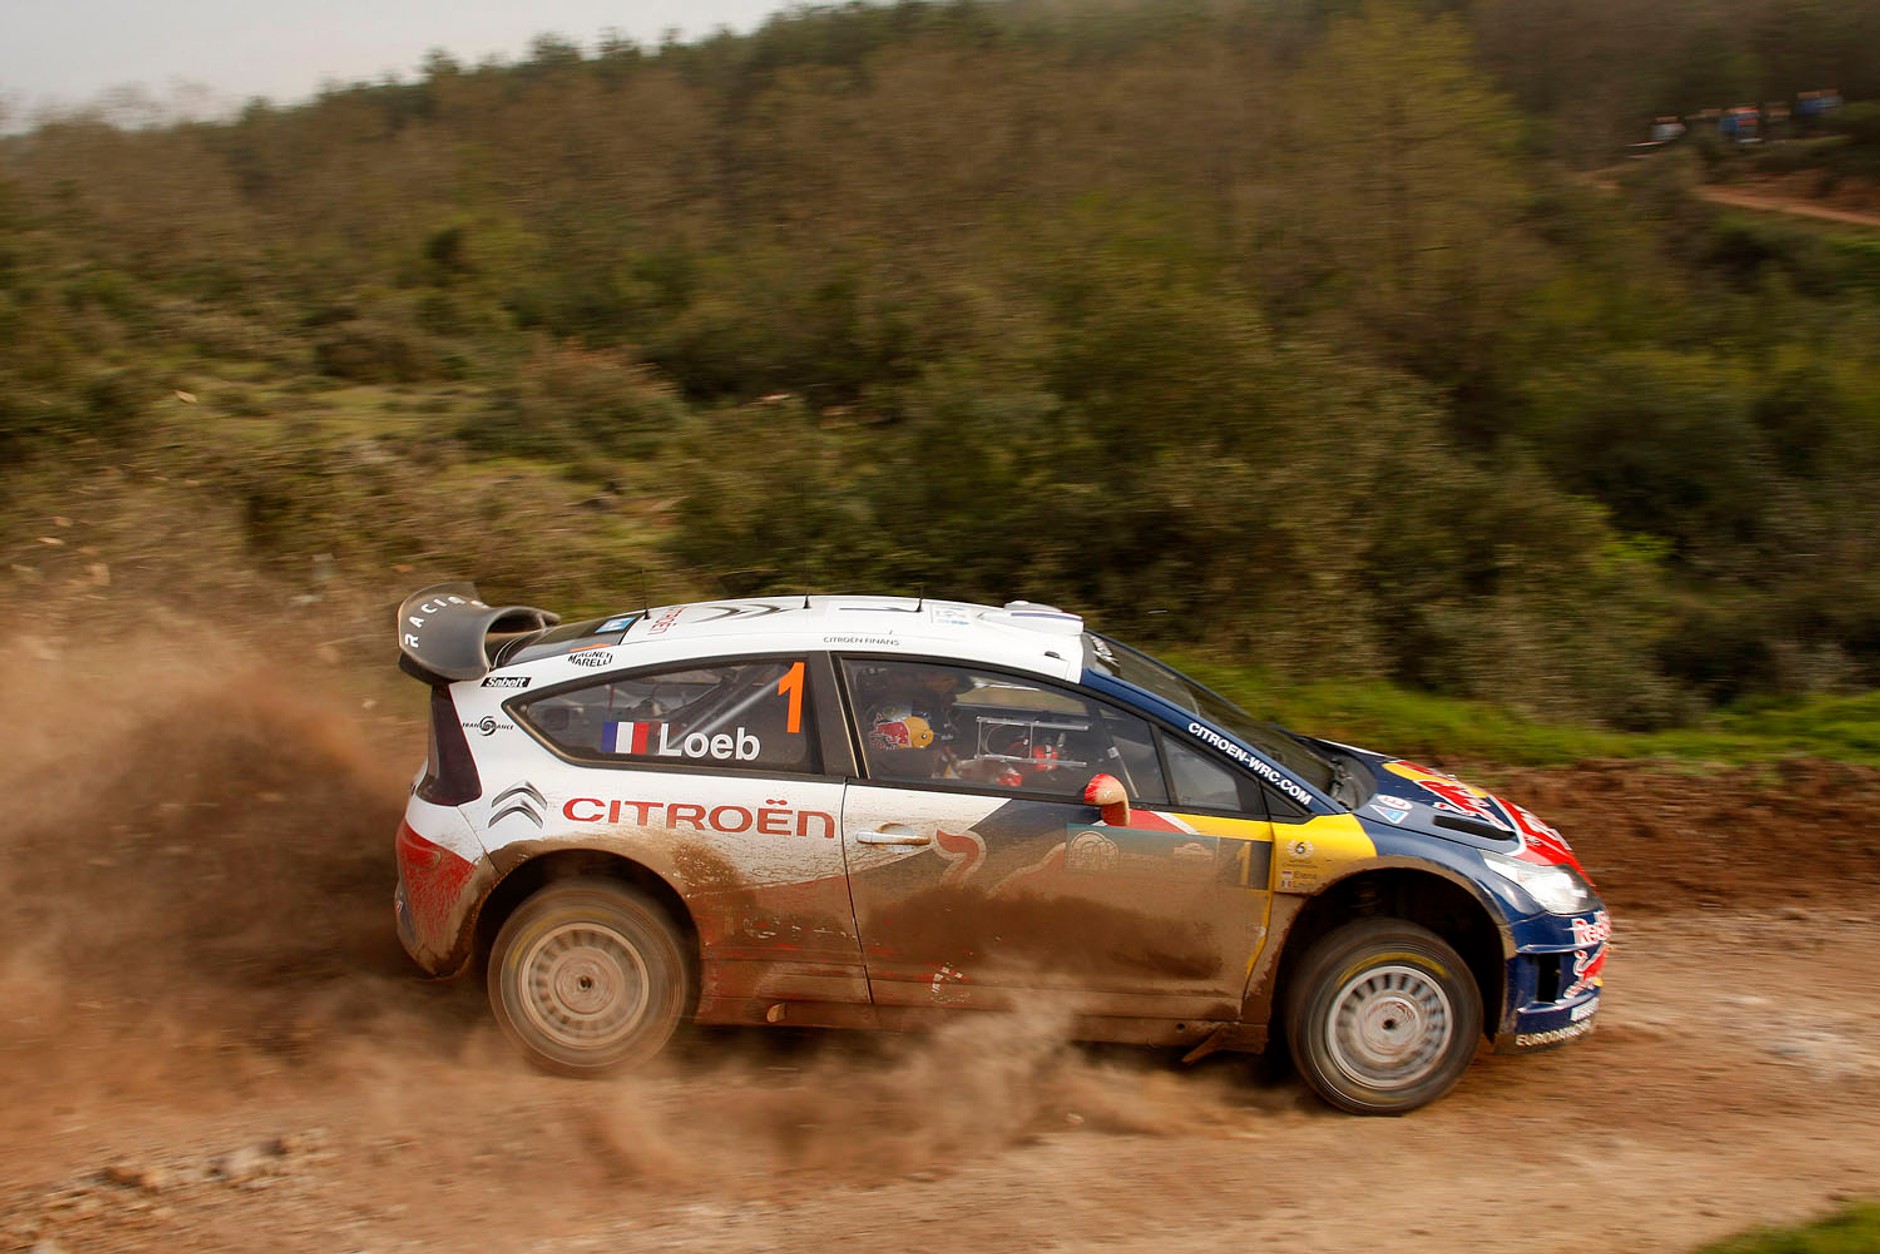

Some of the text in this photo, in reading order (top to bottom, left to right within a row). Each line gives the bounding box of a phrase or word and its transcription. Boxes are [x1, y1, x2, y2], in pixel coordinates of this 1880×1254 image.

[777, 662, 805, 733] 1
[658, 723, 760, 761] Loeb
[1188, 722, 1313, 805] CITROEN-WRC.COM
[1295, 841, 1305, 855] 6
